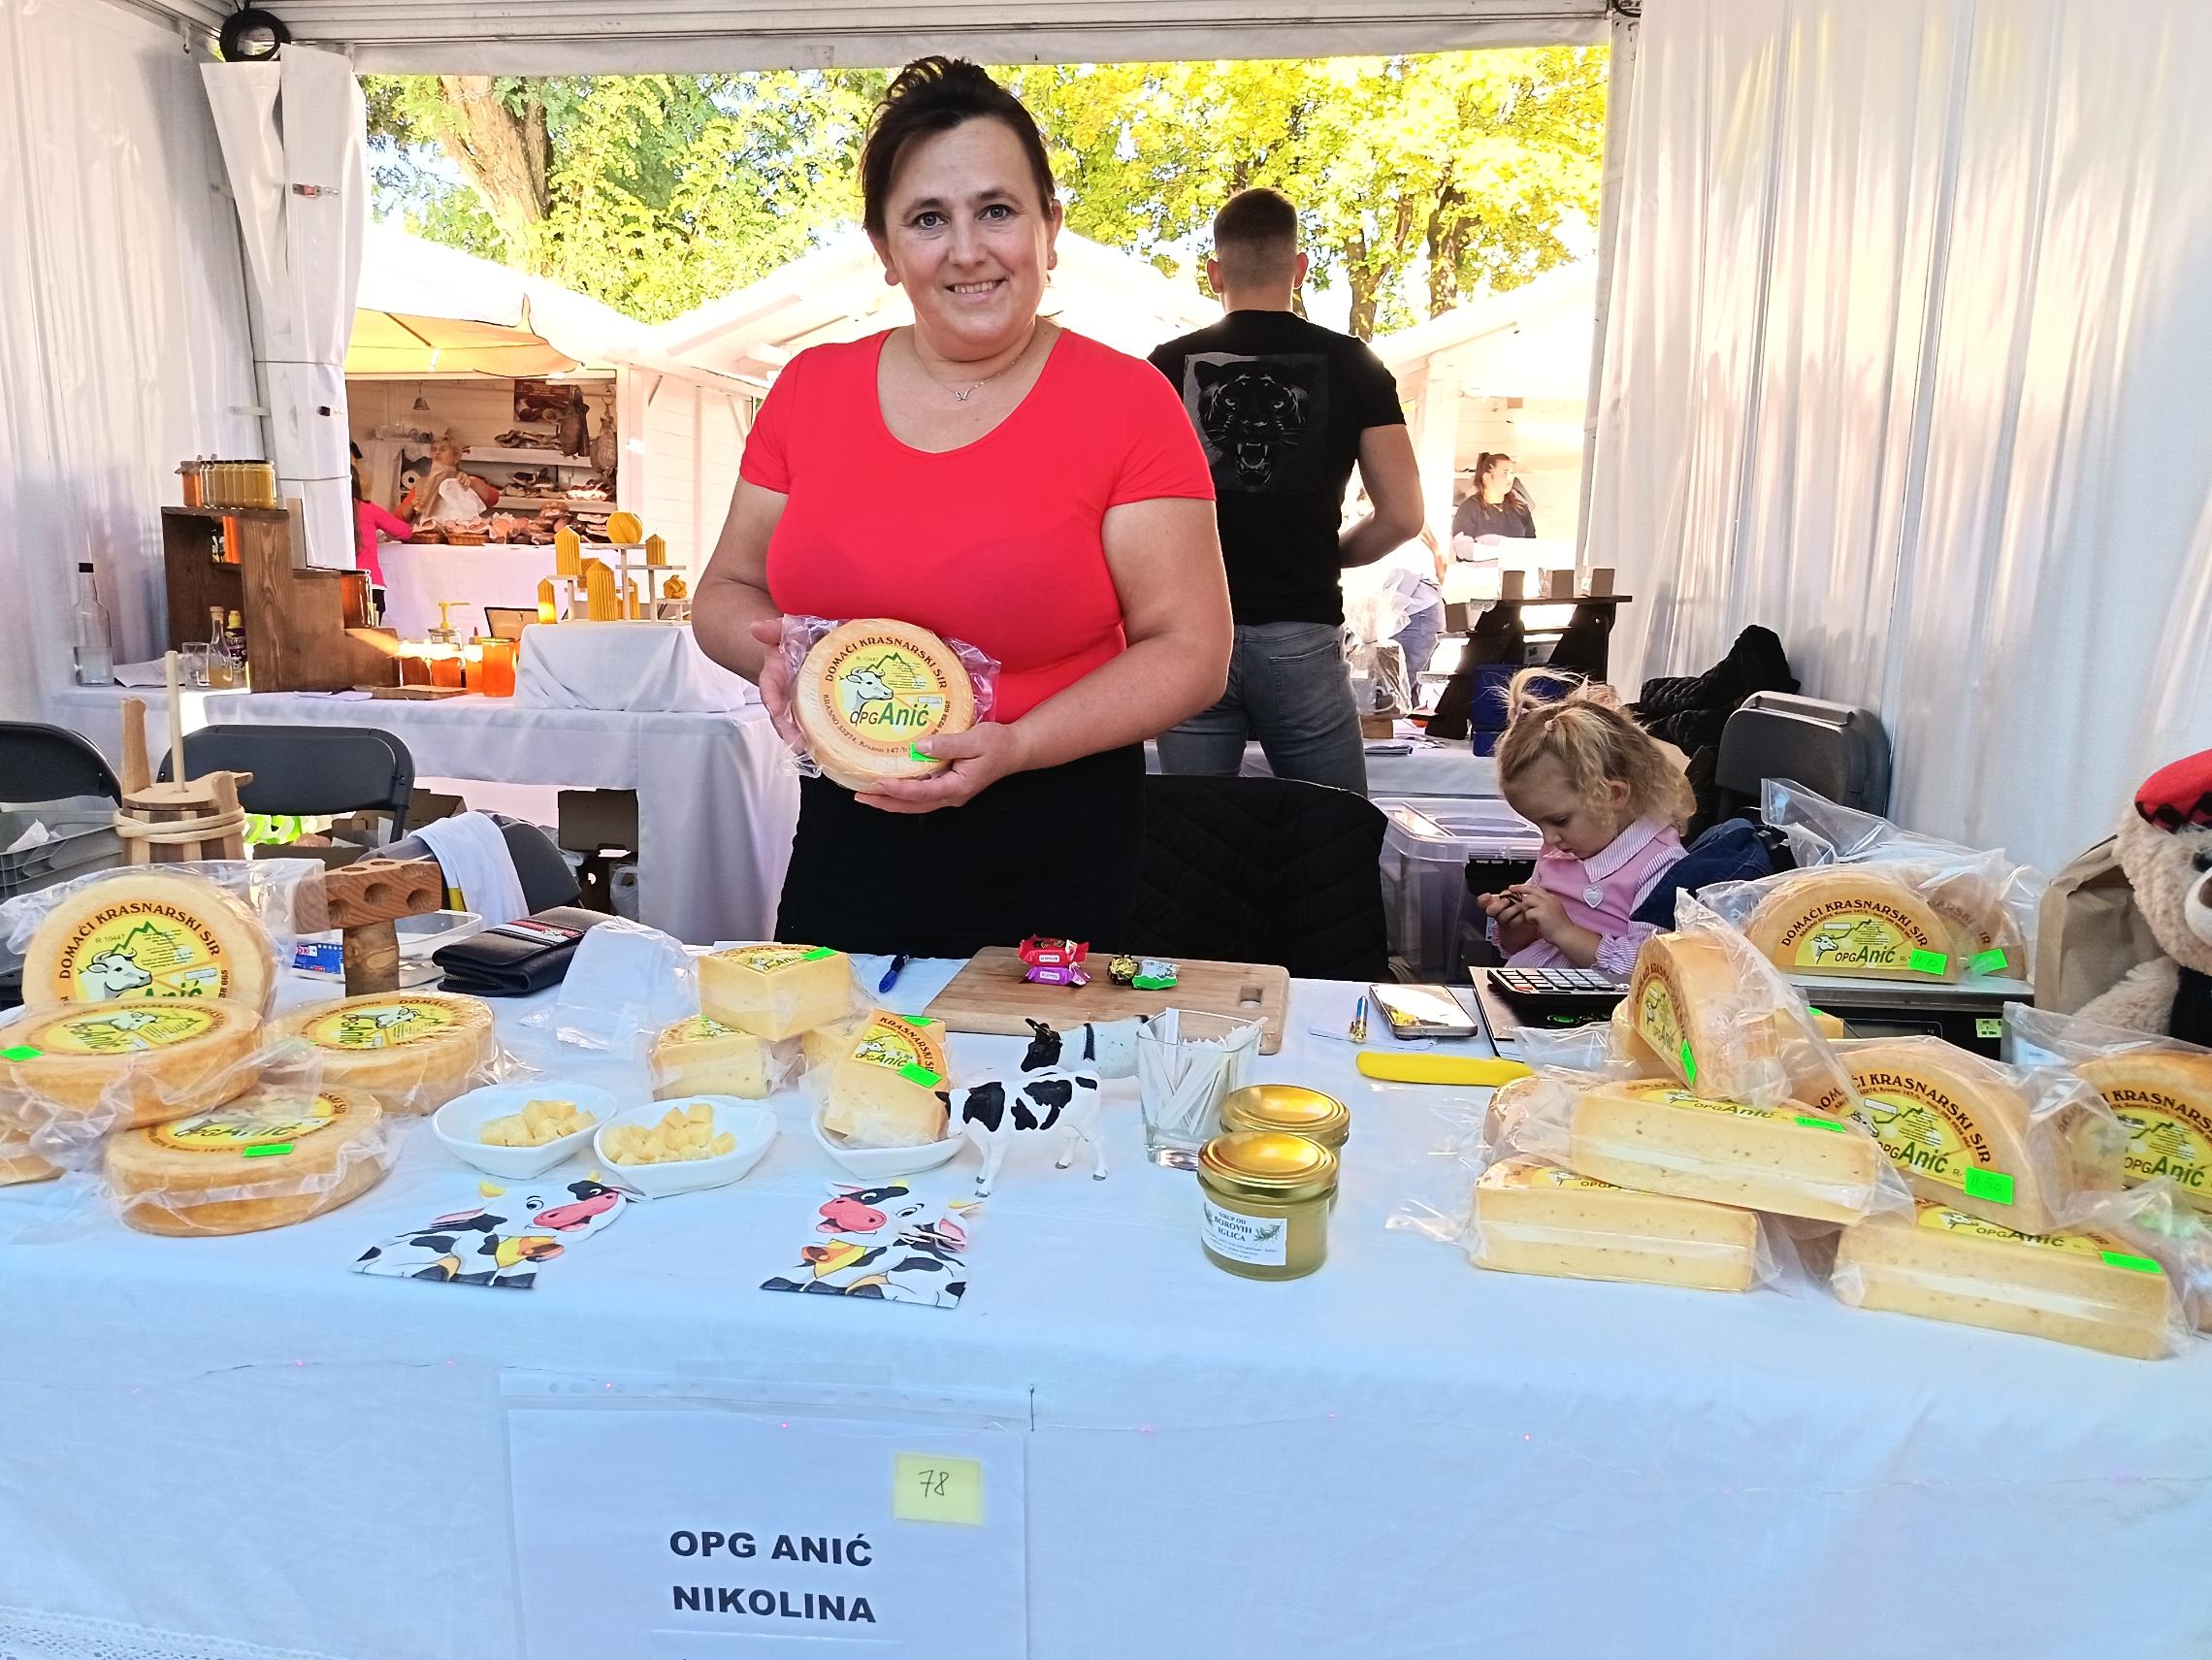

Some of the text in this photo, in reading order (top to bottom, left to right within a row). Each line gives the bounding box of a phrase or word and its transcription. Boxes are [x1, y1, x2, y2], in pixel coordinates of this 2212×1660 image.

[825, 643, 858, 682] DOMAĆI
[859, 636, 936, 668] KRASNARSKI
[933, 668, 948, 689] SIR
[59, 921, 96, 979] DOMAĆI
[95, 902, 202, 931] KRASNARSKI
[200, 930, 221, 957] SIR
[1780, 907, 1823, 947] DOMAĆI
[1825, 899, 1910, 928] KRASNARSKI
[1909, 927, 1929, 948] SIR
[879, 1017, 933, 1059] KRASNARSKI
[1870, 1073, 1973, 1133] KRASNARSKI
[1970, 1132, 1991, 1164] SIR
[2111, 1090, 2212, 1133] KRASNARS
[1214, 1216, 1252, 1234] BOROVIH
[1218, 1226, 1246, 1242] IGLICA
[918, 1469, 950, 1498] 78
[669, 1529, 873, 1568] OPG ANIĆ
[672, 1584, 877, 1623] NIKOLINA
